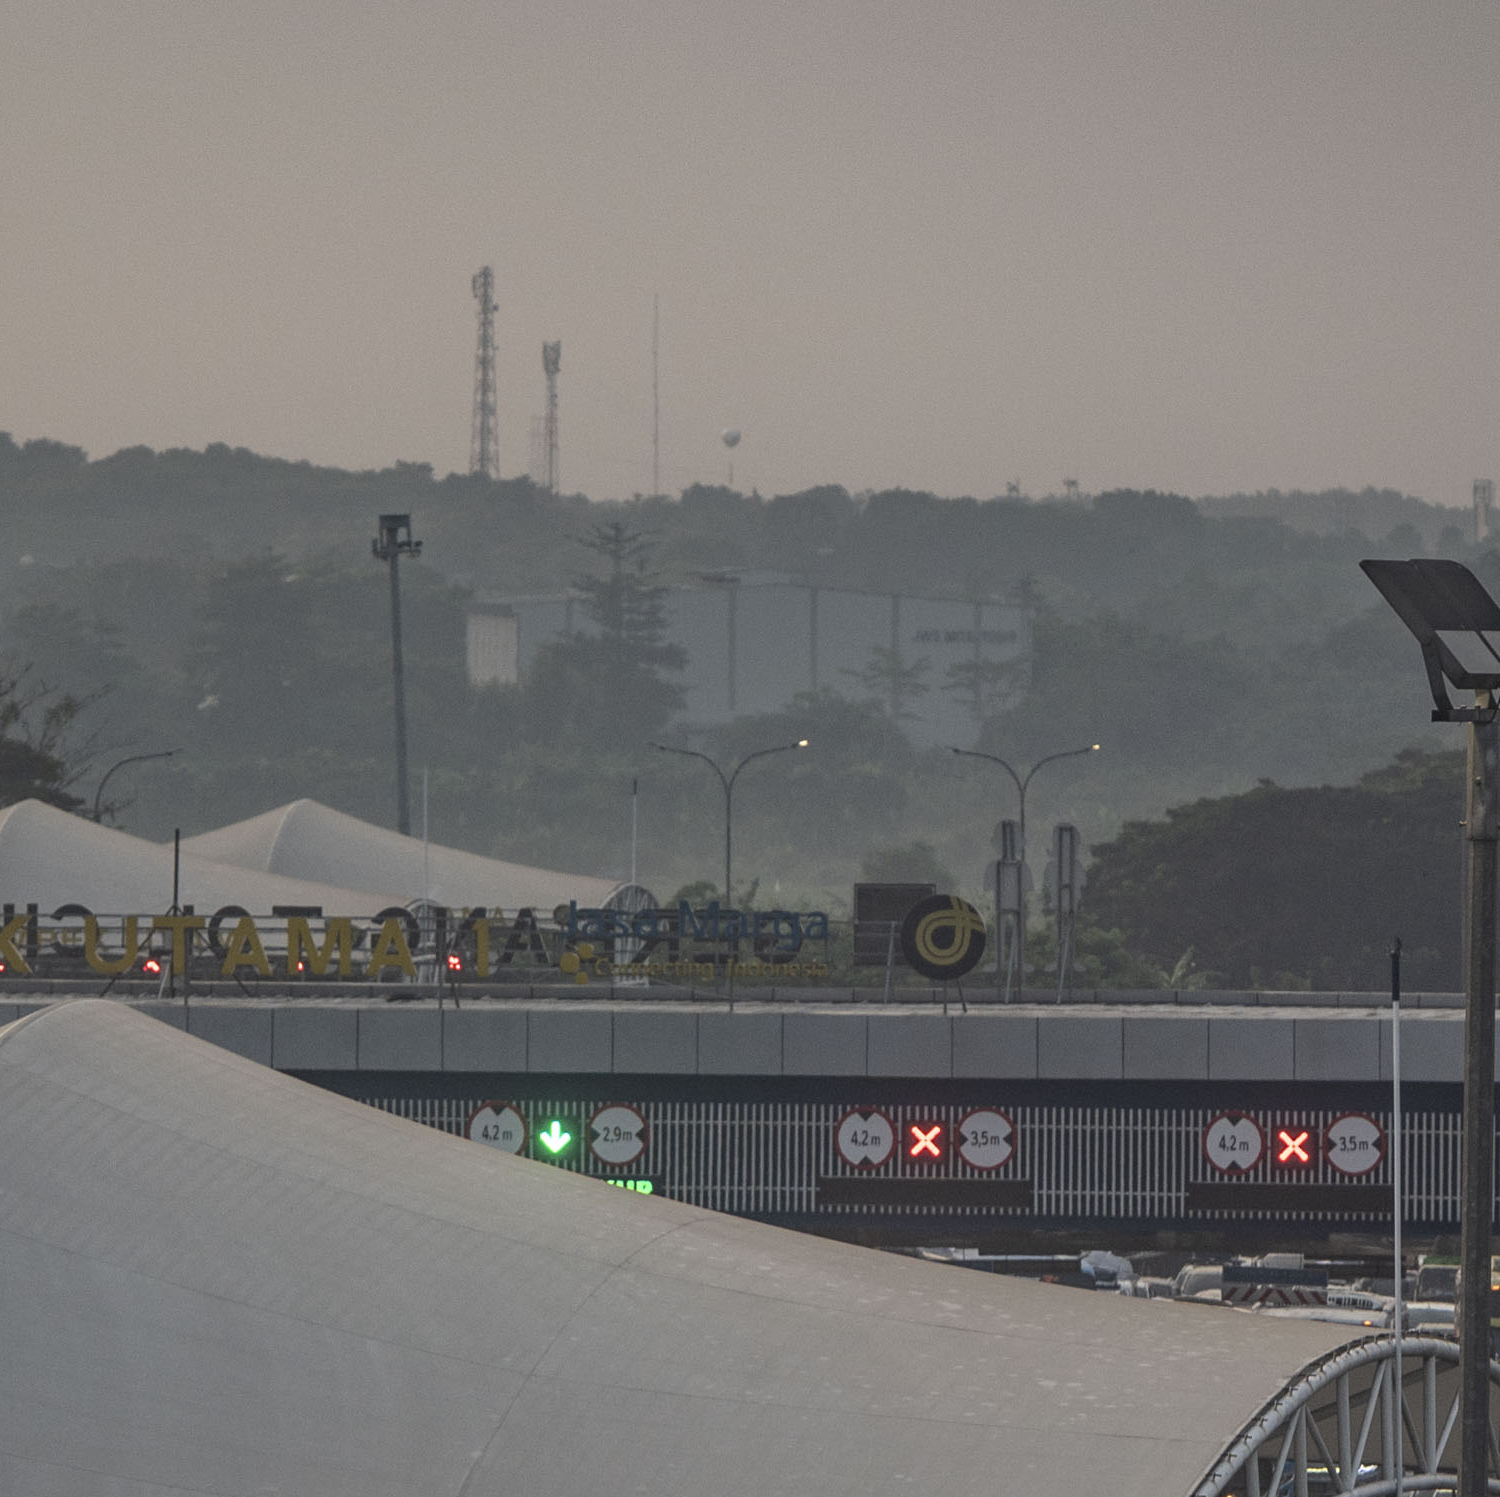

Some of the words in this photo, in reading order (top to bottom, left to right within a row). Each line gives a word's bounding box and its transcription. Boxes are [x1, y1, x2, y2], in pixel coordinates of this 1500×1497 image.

[84, 915, 419, 978] UTAMA
[470, 917, 492, 979] 1
[558, 900, 658, 944] Jasa
[678, 901, 826, 952] Marga
[593, 957, 715, 983] Connecting
[727, 957, 829, 979] Indonesia
